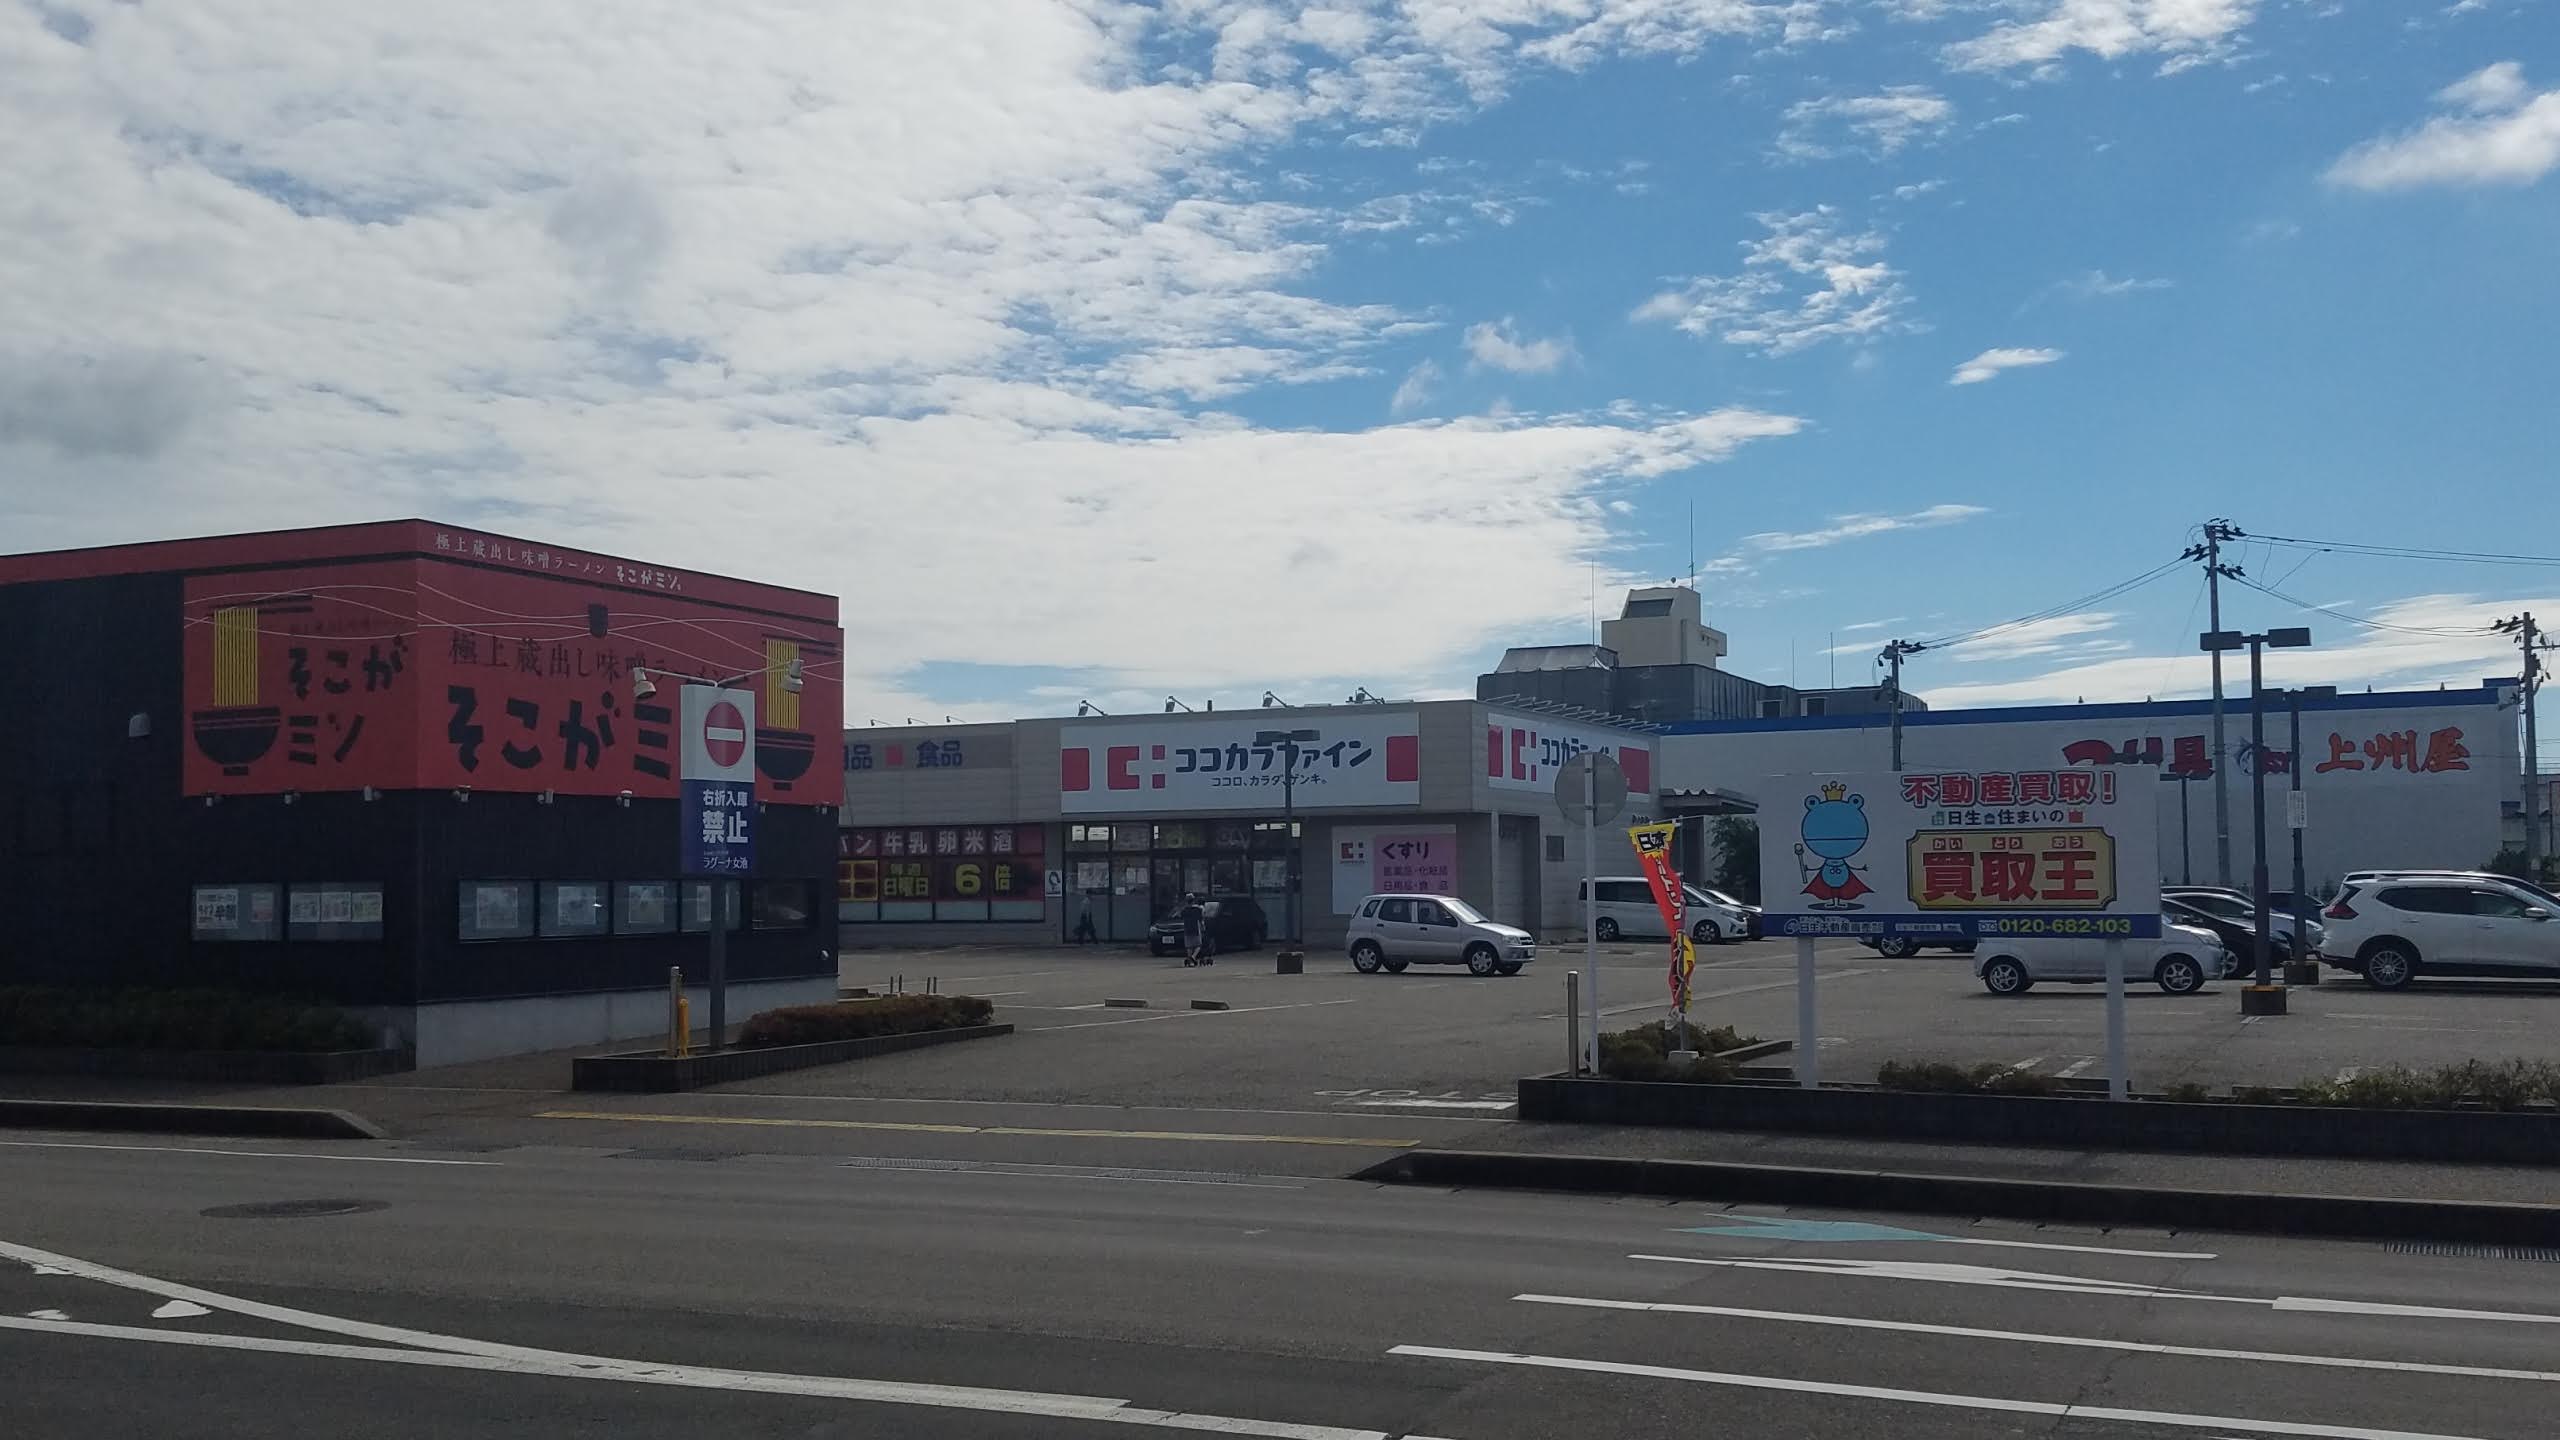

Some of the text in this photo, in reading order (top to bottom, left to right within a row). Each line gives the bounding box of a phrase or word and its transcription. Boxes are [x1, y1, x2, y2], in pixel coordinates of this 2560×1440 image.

[288, 634, 408, 701] そこが
[288, 712, 366, 766] ミソ
[843, 738, 963, 770] 品 食品
[2314, 725, 2472, 775] 上州屋
[1175, 741, 1373, 773] ココカラファイン
[703, 789, 749, 808] 右折入庫
[702, 809, 749, 844] 禁止
[1948, 809, 2065, 826] 日生 住まいの
[1383, 840, 1429, 860] くすり
[1922, 850, 2099, 902] 買取王
[1999, 918, 2131, 934] 0120-682-103
